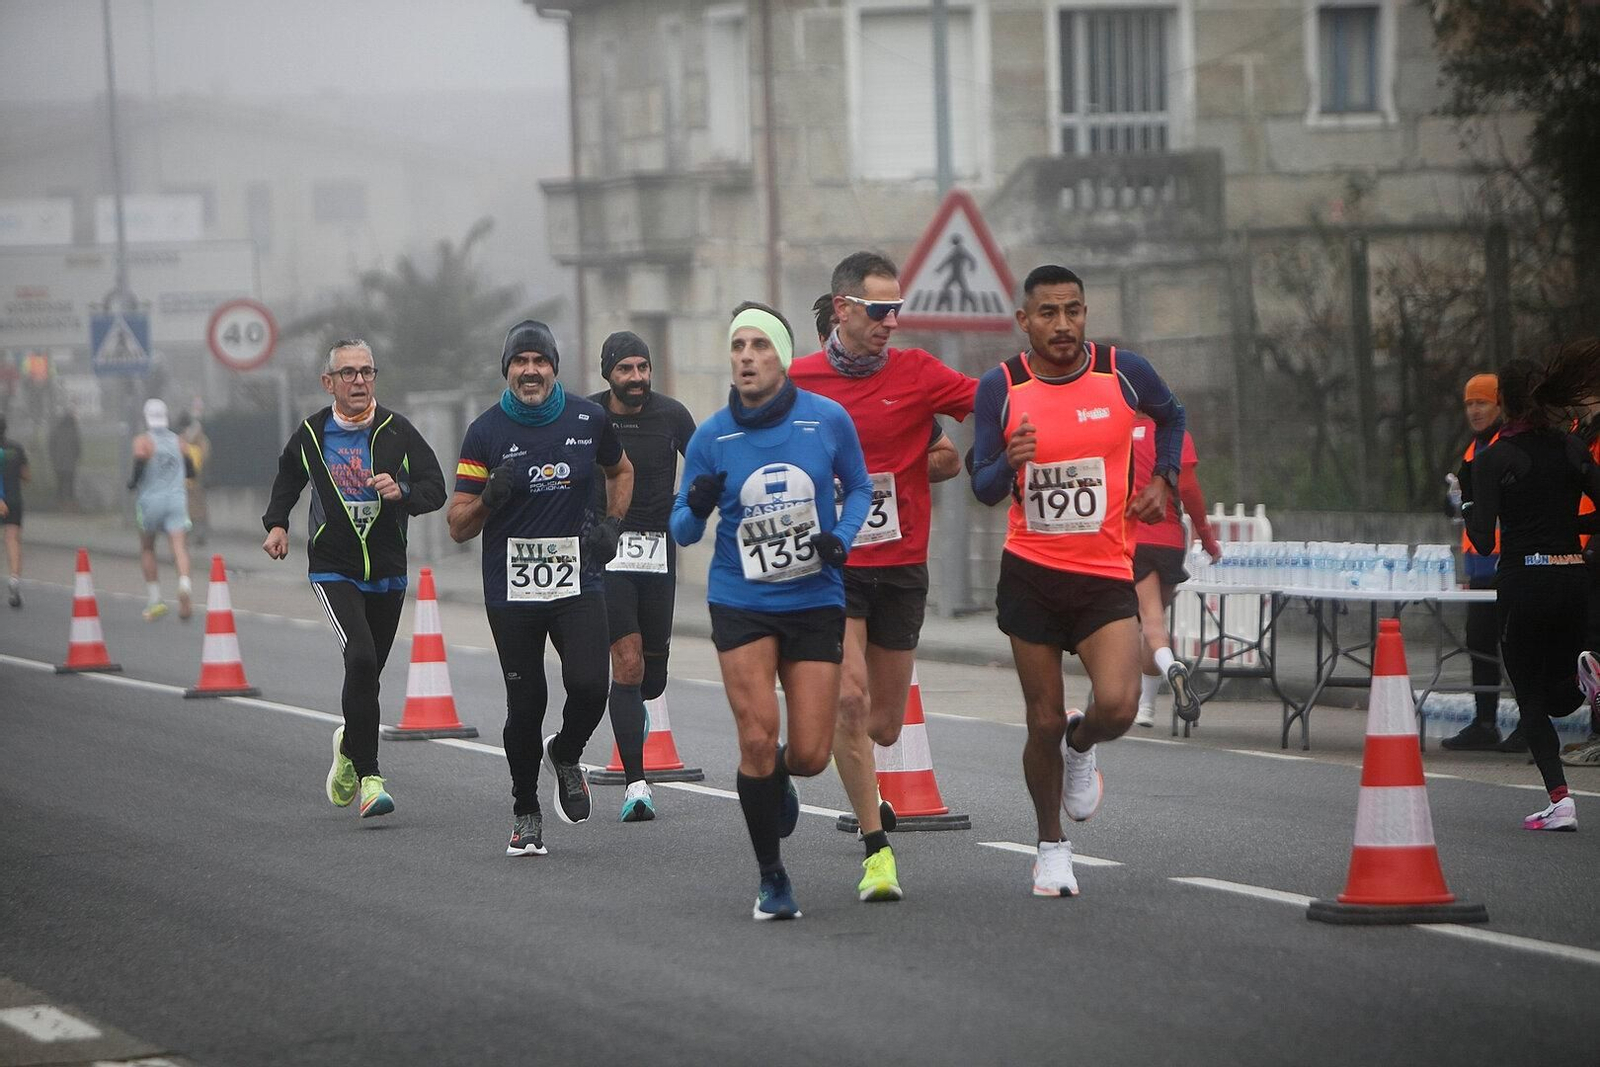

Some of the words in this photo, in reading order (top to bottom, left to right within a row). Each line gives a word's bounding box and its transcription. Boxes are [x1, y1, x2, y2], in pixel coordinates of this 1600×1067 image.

[223, 321, 264, 346] 40
[502, 450, 527, 460] Santander
[528, 462, 571, 484] 200
[1033, 466, 1062, 487] XXI
[1029, 487, 1097, 519] 190
[743, 517, 778, 545] XXI
[515, 543, 543, 559] XXI
[618, 536, 660, 559] 157
[749, 530, 816, 573] 135
[510, 563, 574, 588] 302
